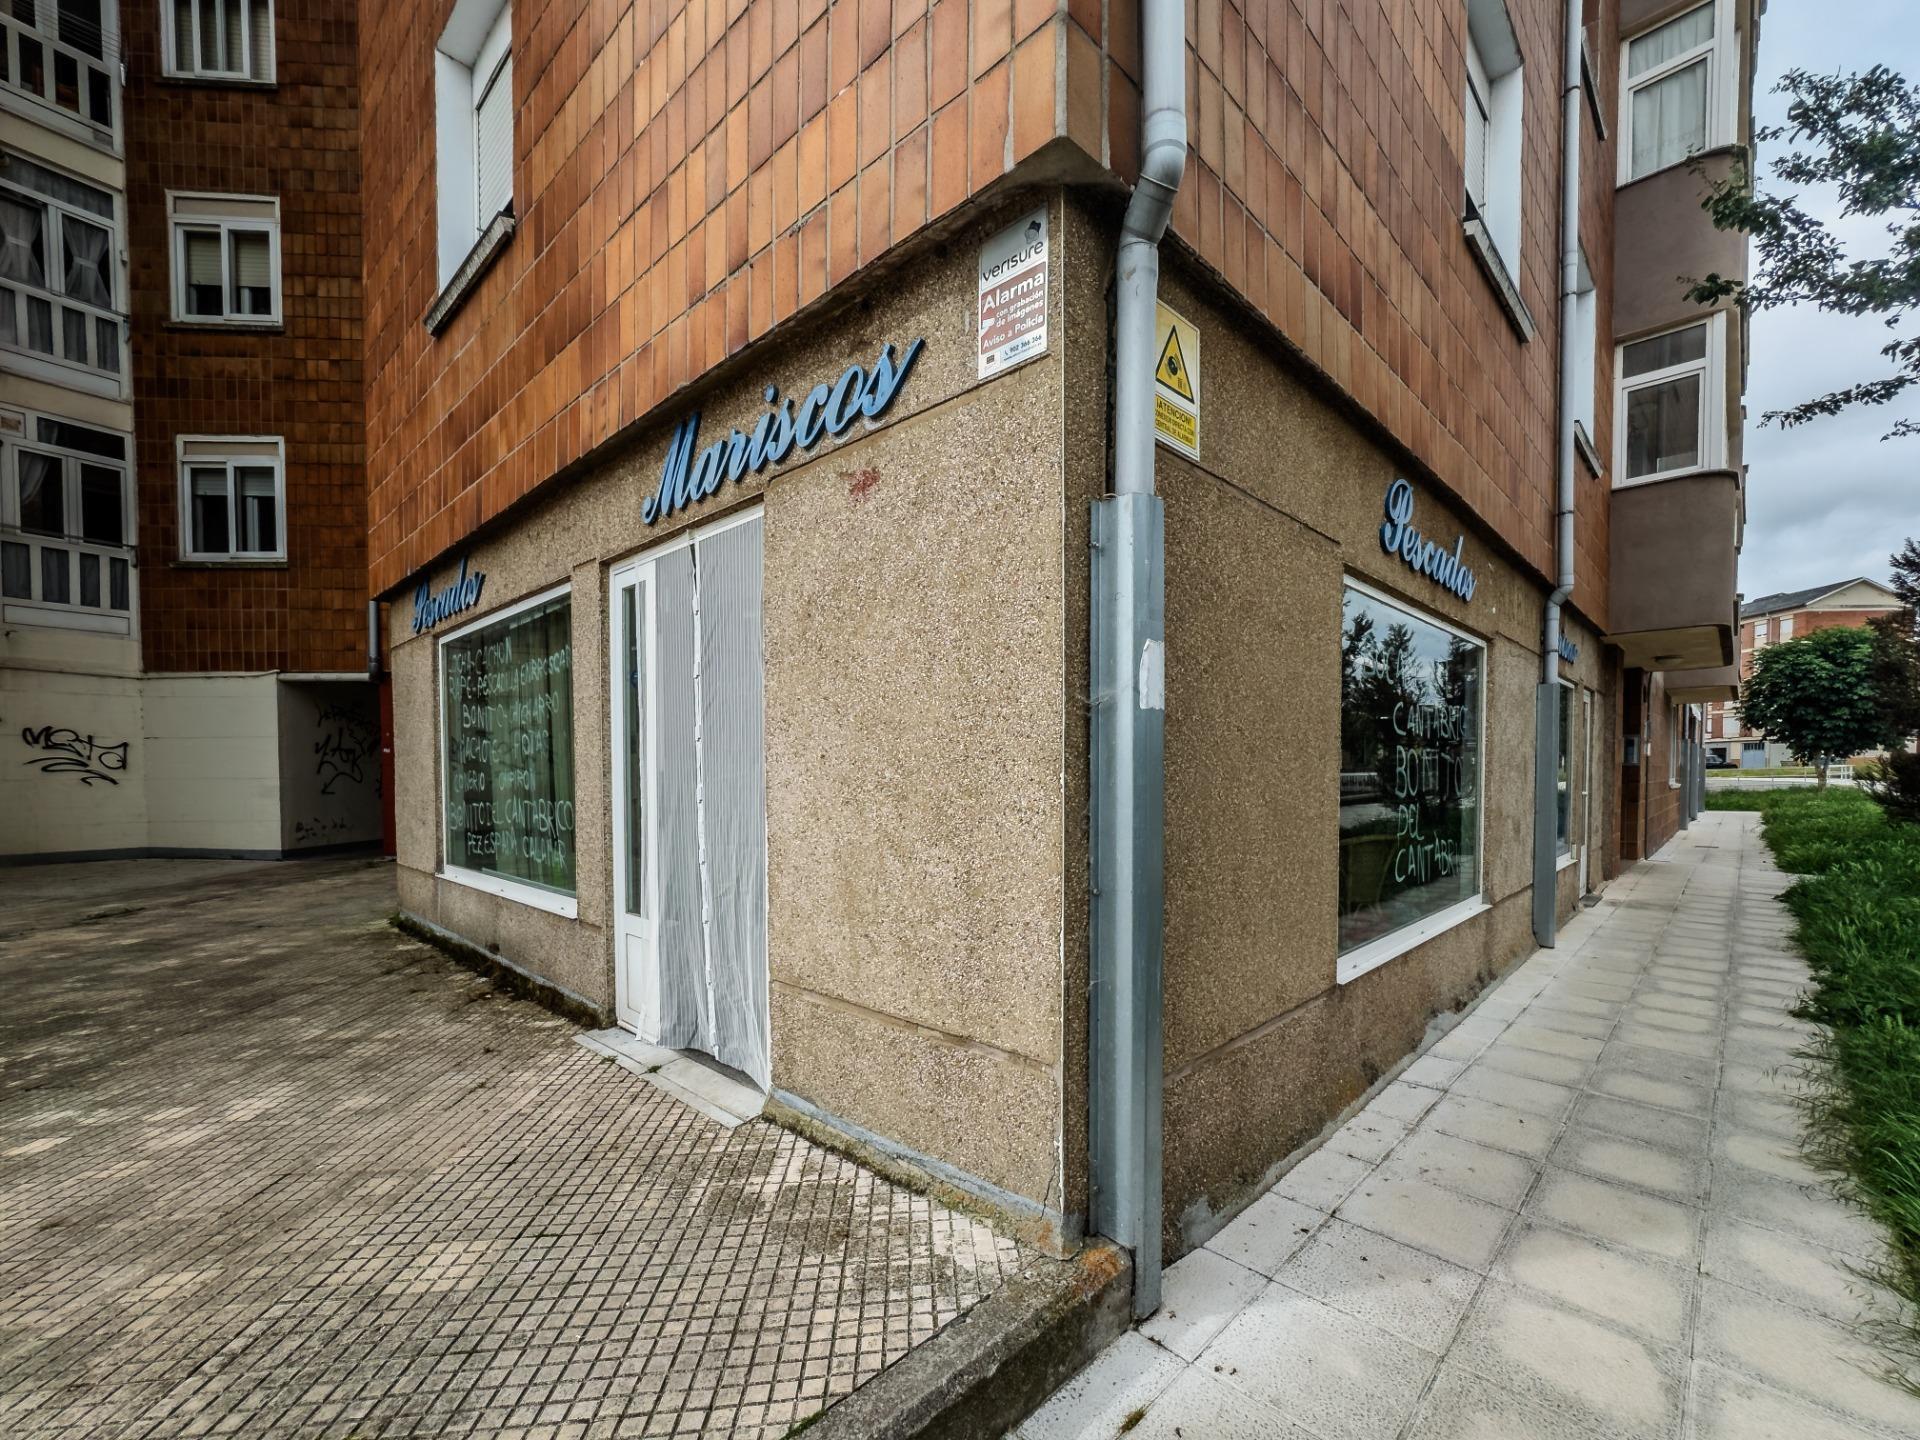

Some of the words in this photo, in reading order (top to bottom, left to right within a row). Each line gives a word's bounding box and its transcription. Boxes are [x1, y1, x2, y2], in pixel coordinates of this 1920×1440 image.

[983, 241, 1043, 282] verisure
[983, 272, 1044, 315] Alarma
[983, 333, 1006, 351] Aviso
[640, 337, 926, 525] Mariscos
[1380, 478, 1477, 602] Pescados
[1397, 803, 1424, 848] DEL
